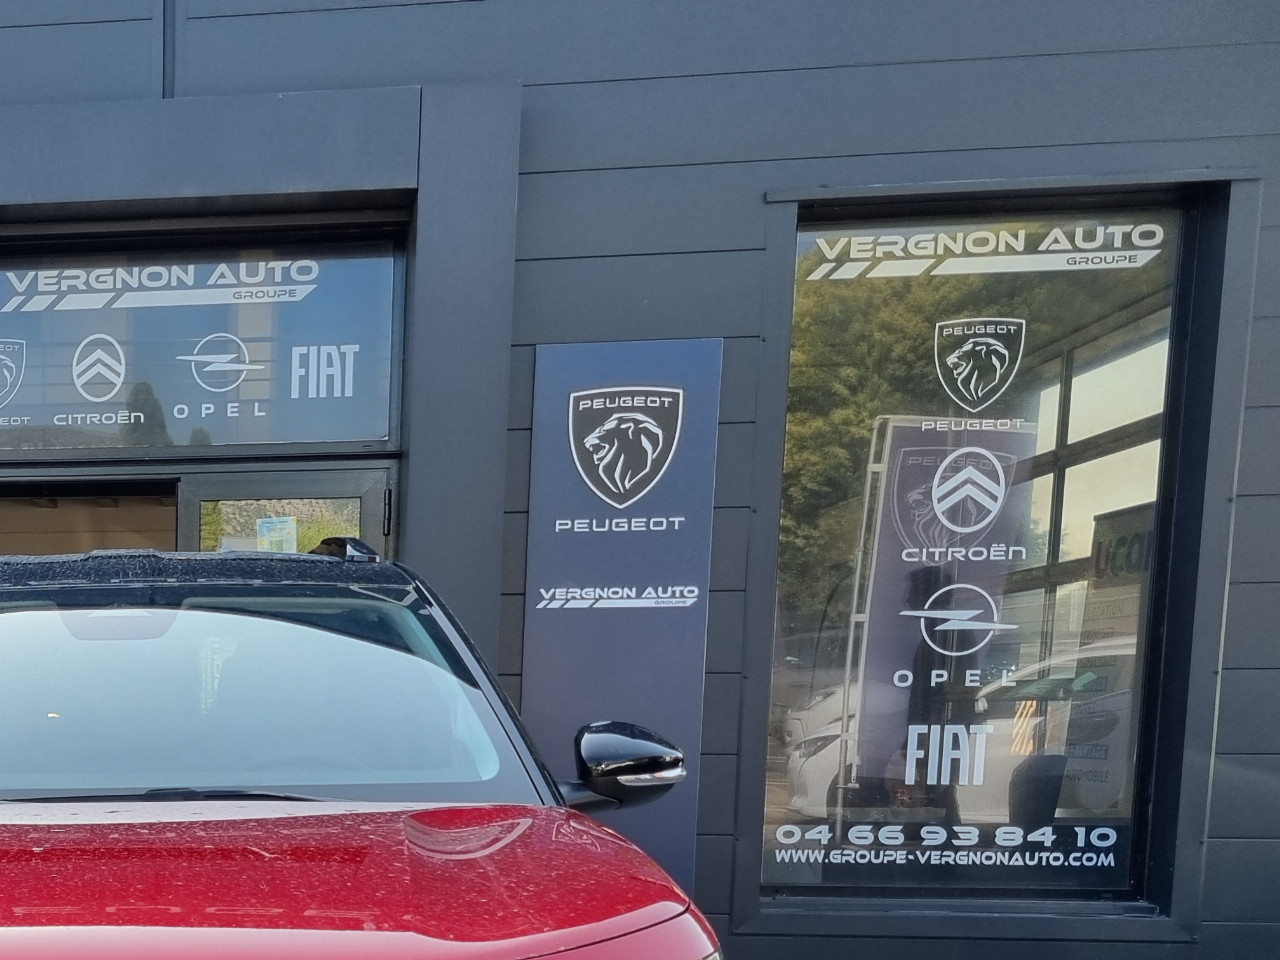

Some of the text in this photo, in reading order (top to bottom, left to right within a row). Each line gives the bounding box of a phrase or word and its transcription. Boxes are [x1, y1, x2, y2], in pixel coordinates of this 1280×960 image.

[815, 223, 1165, 260] VERGNON AUTO
[1066, 254, 1138, 266] GROUPE
[6, 259, 320, 294] VERGNON AUTO
[232, 288, 298, 300] GROUPE
[942, 324, 1018, 336] PEUGEOT
[290, 344, 360, 399] FIAT
[173, 402, 267, 419] OPEL
[578, 396, 673, 411] PEUGEOT
[921, 418, 1025, 432] PEUGEOT
[555, 517, 686, 533] PEUGEOT
[539, 585, 699, 600] VERGNON AUTO
[893, 669, 1017, 688] OPEL
[904, 724, 994, 786] FIAT
[775, 825, 1118, 848] 04 66 93 84 10
[775, 849, 1116, 868] WWW.GROUPE-VERGNONAUTO.COM
